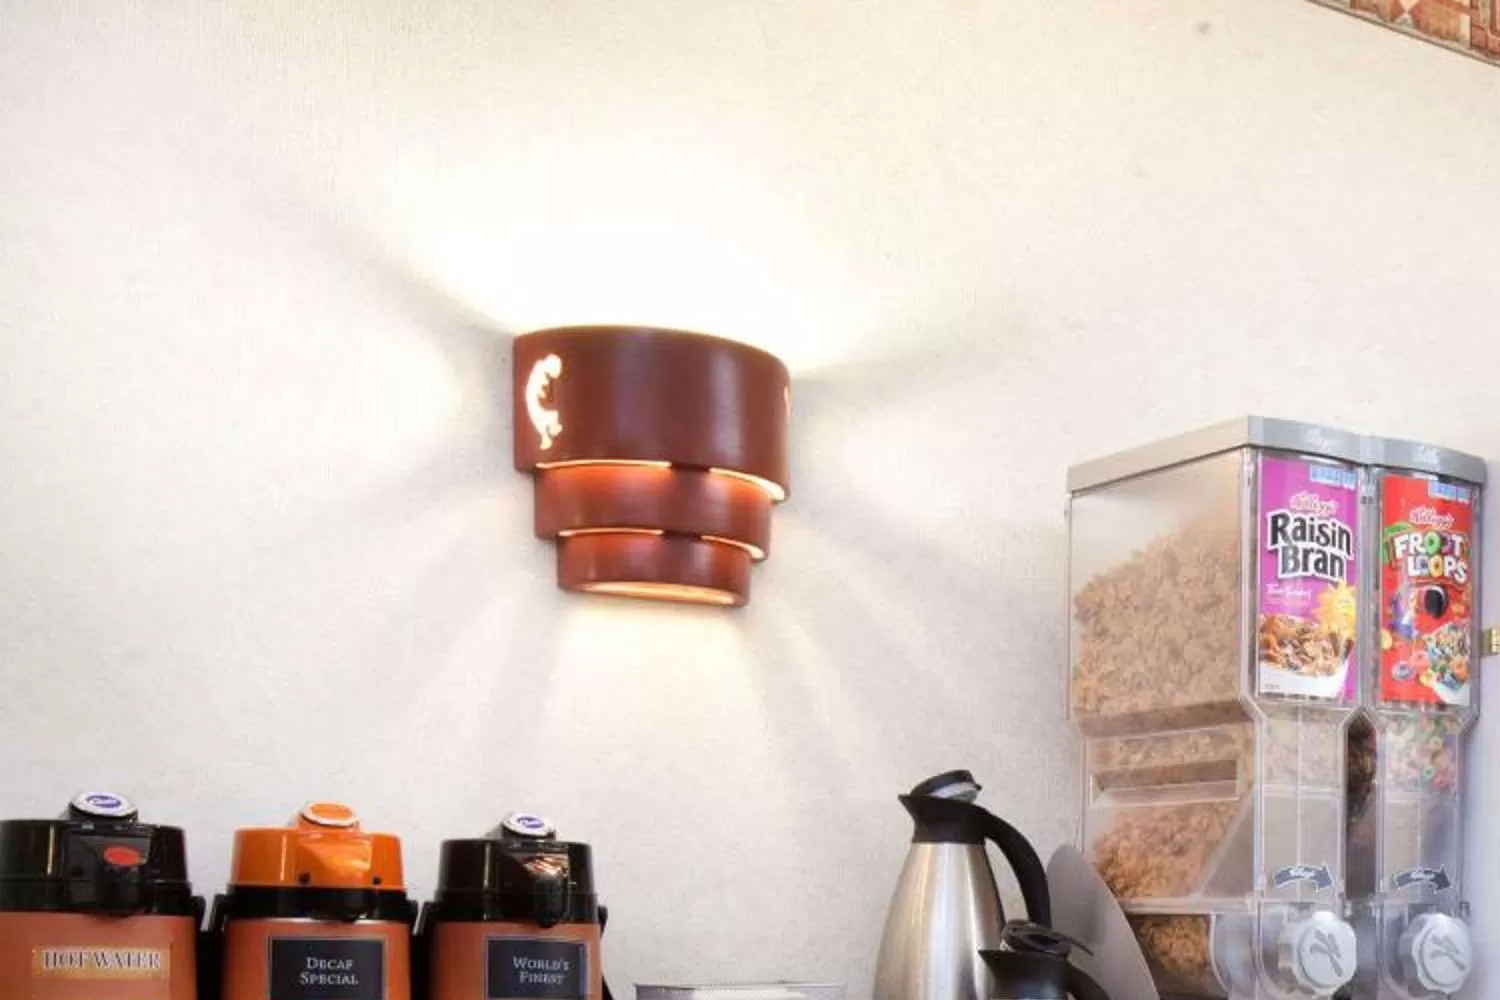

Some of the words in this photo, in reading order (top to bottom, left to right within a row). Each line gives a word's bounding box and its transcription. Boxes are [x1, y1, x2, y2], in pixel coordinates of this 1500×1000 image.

[1268, 511, 1353, 557] Raisin
[1279, 545, 1346, 580] Bran
[1407, 555, 1468, 584] LOOPS
[299, 971, 359, 985] SPECIAL
